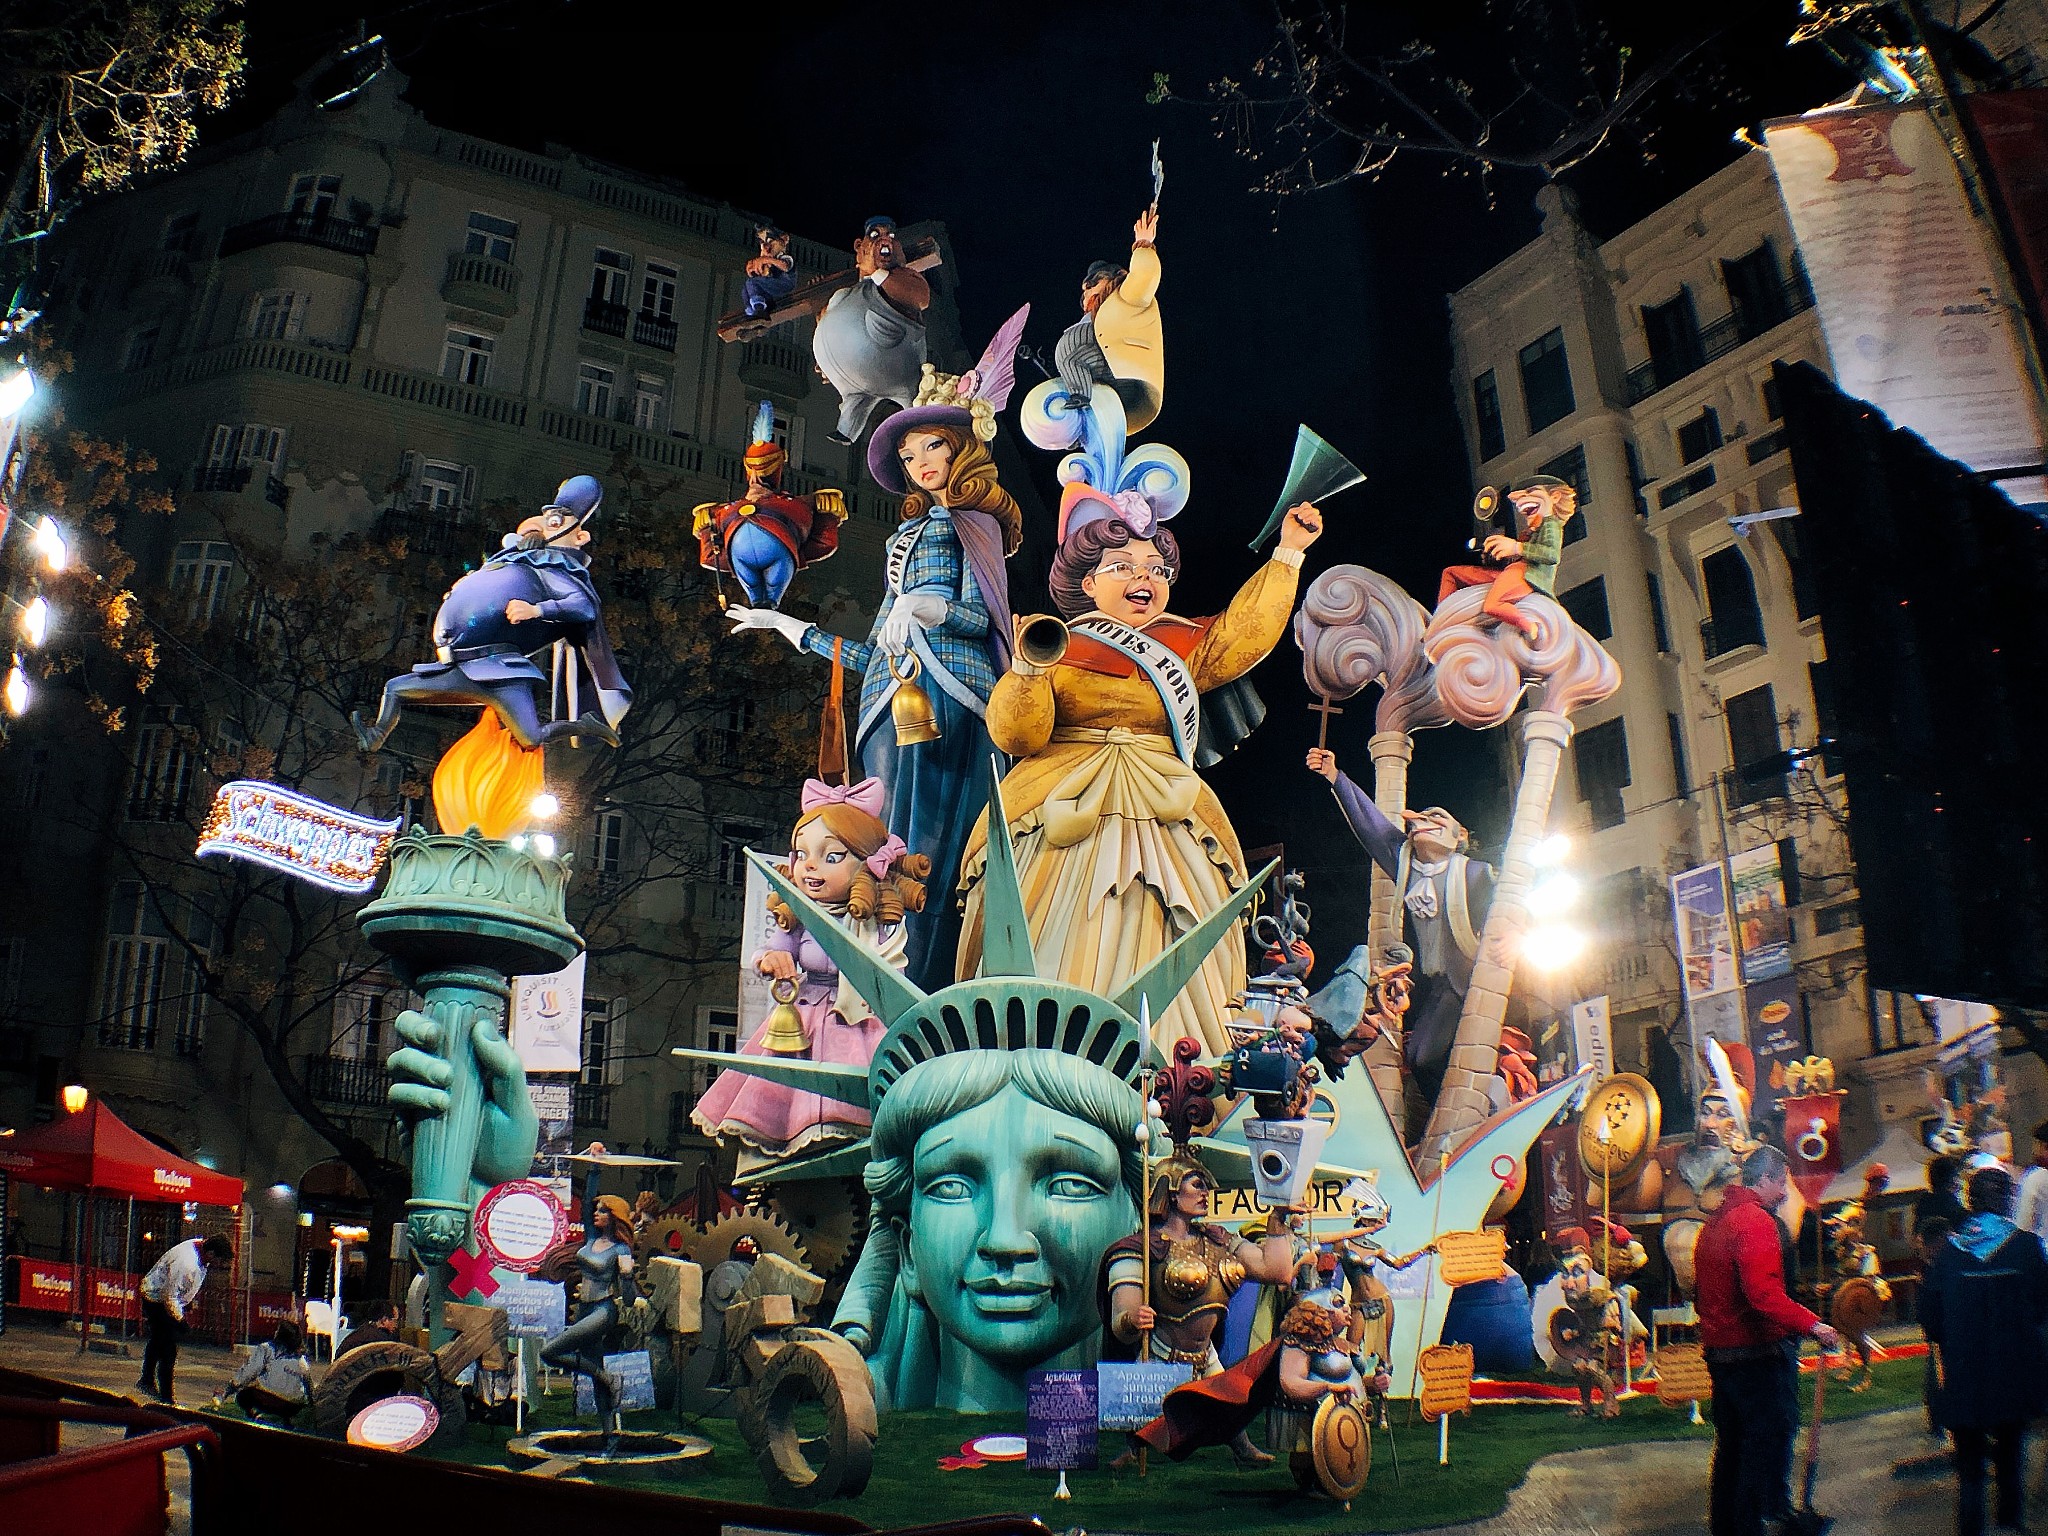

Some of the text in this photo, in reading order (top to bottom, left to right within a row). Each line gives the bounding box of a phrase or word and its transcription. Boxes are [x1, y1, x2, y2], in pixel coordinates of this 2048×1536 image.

[889, 527, 920, 586] OMEN
[1086, 621, 1151, 655] VOTES
[1155, 655, 1190, 704] FOR
[229, 790, 379, 872] Schweppes
[154, 1168, 191, 1188] Mahou
[1213, 1180, 1366, 1215] FACOR
[32, 1272, 73, 1292] Mahou
[544, 1297, 558, 1307] de
[1122, 1392, 1133, 1404] al
